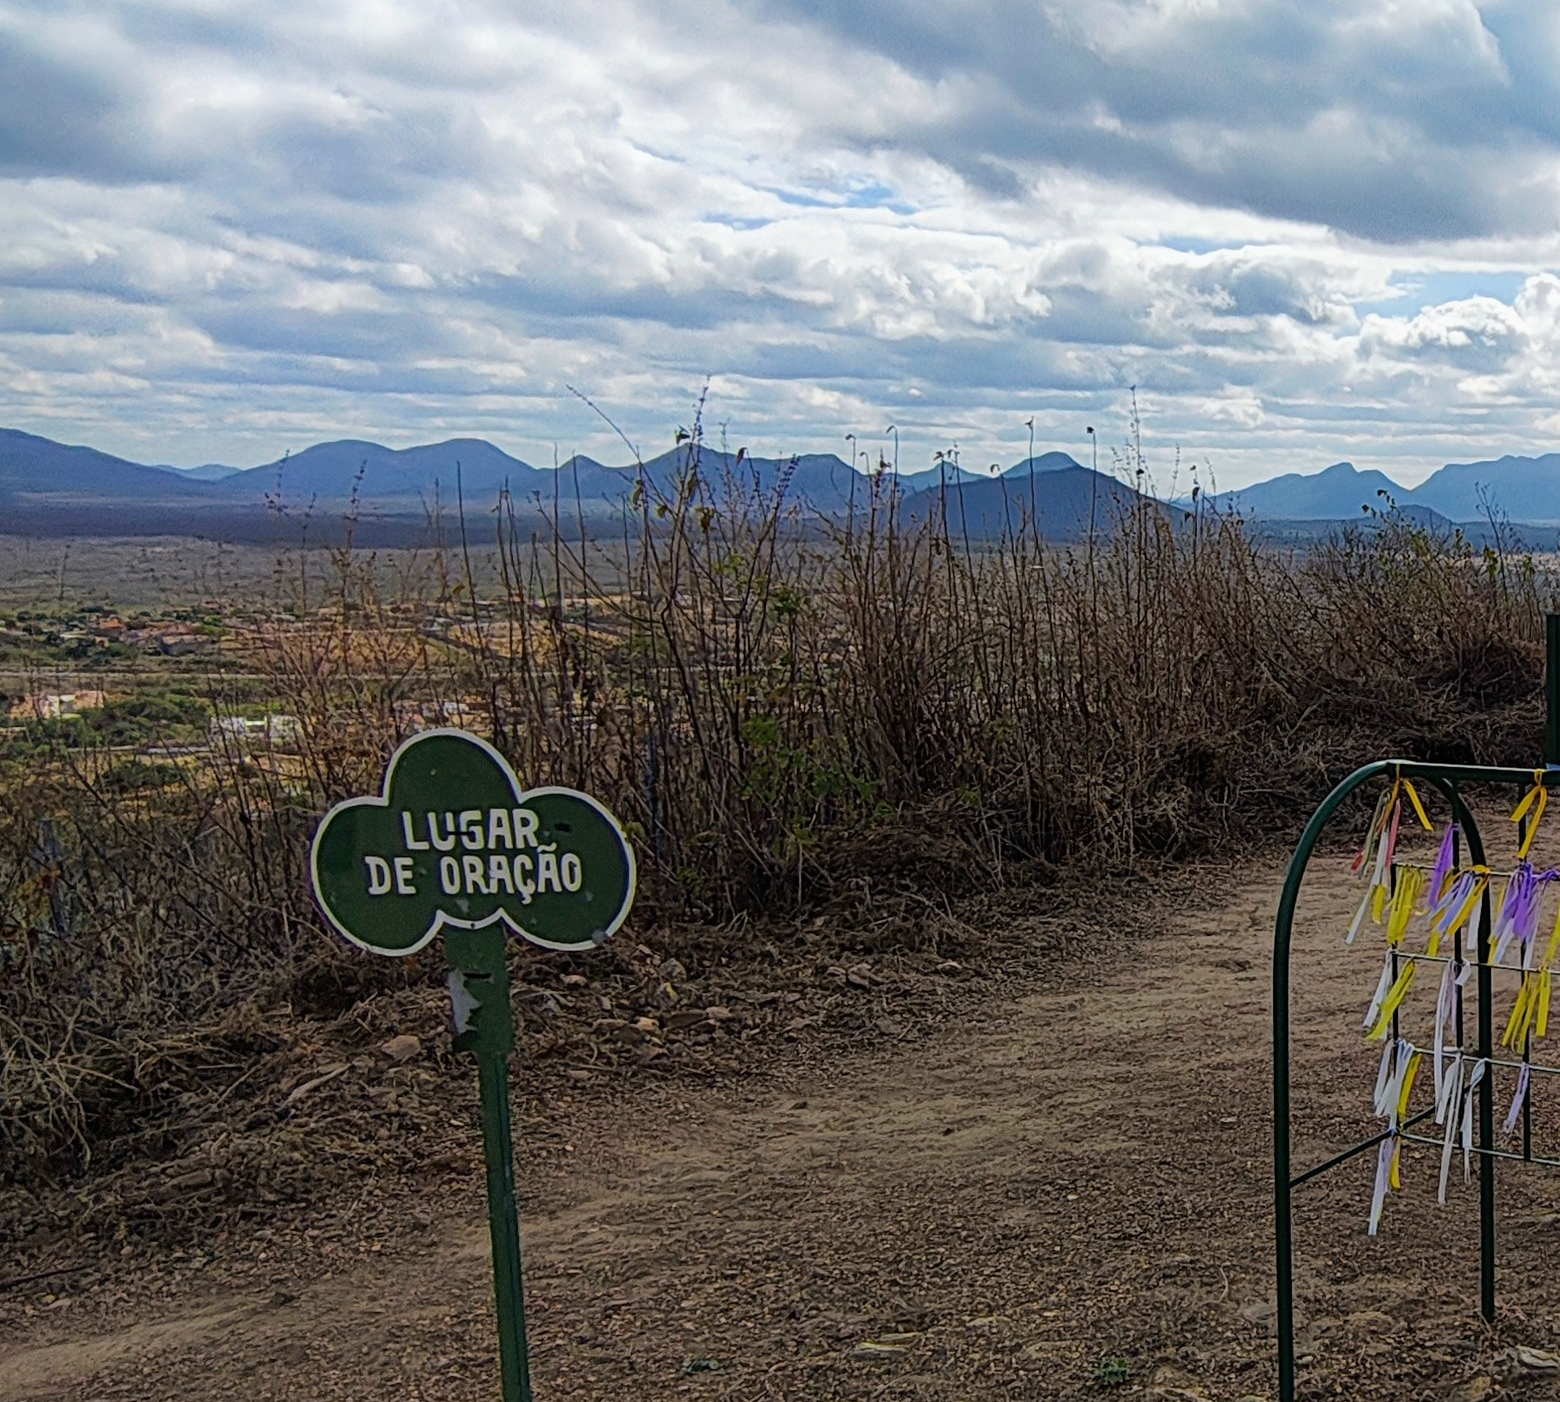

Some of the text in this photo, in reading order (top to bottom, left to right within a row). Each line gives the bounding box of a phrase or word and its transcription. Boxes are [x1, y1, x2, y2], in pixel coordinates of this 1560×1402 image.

[402, 808, 540, 851] LUGAR
[364, 841, 583, 905] DE ORAÇÃO
